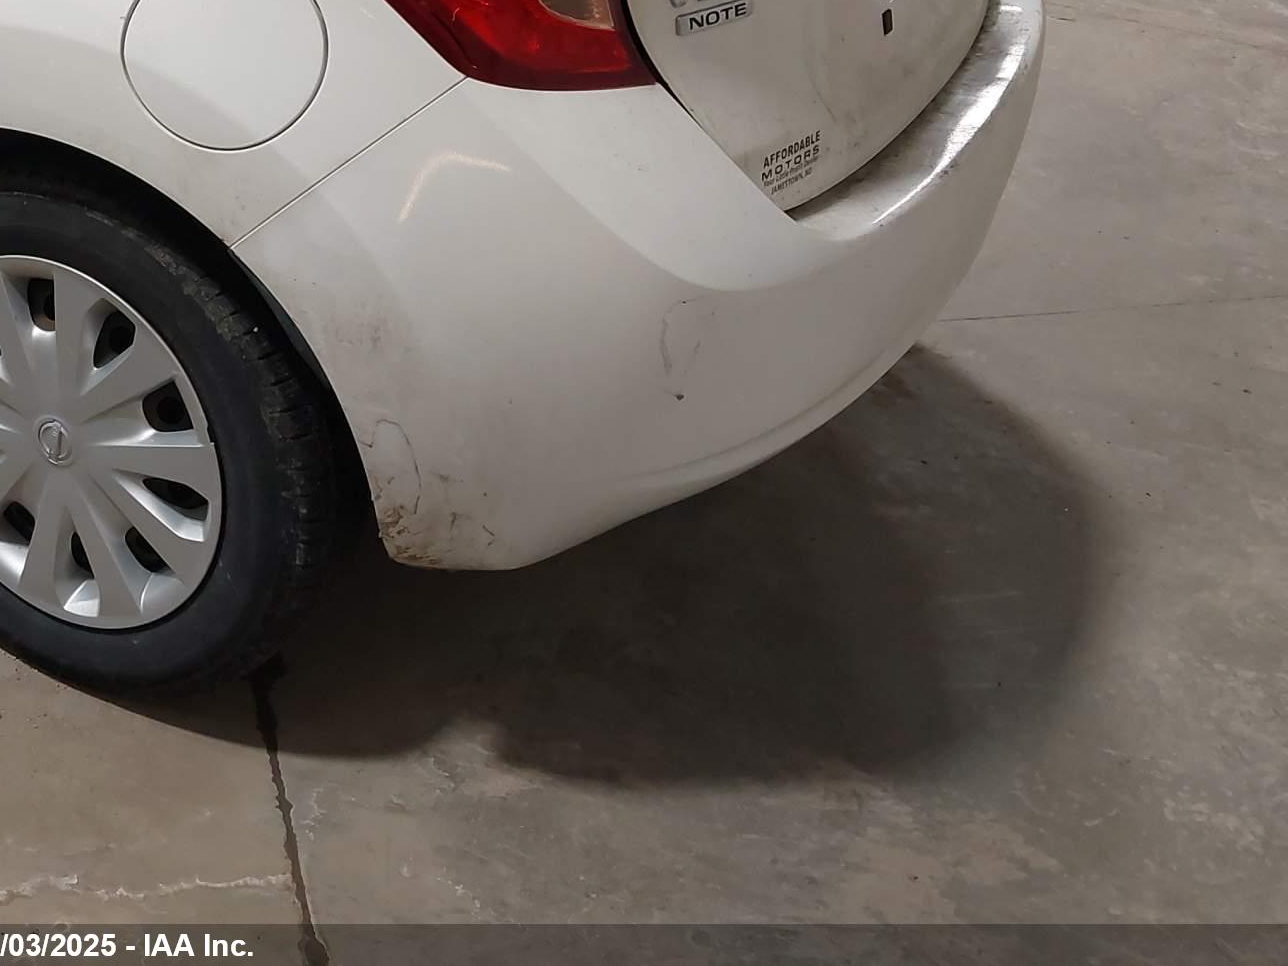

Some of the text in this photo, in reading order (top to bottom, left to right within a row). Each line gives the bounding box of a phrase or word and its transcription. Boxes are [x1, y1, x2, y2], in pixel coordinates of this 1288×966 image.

[689, 2, 747, 30] NOTE
[761, 144, 820, 181] MOTORS
[763, 130, 821, 169] AFFORDABLE
